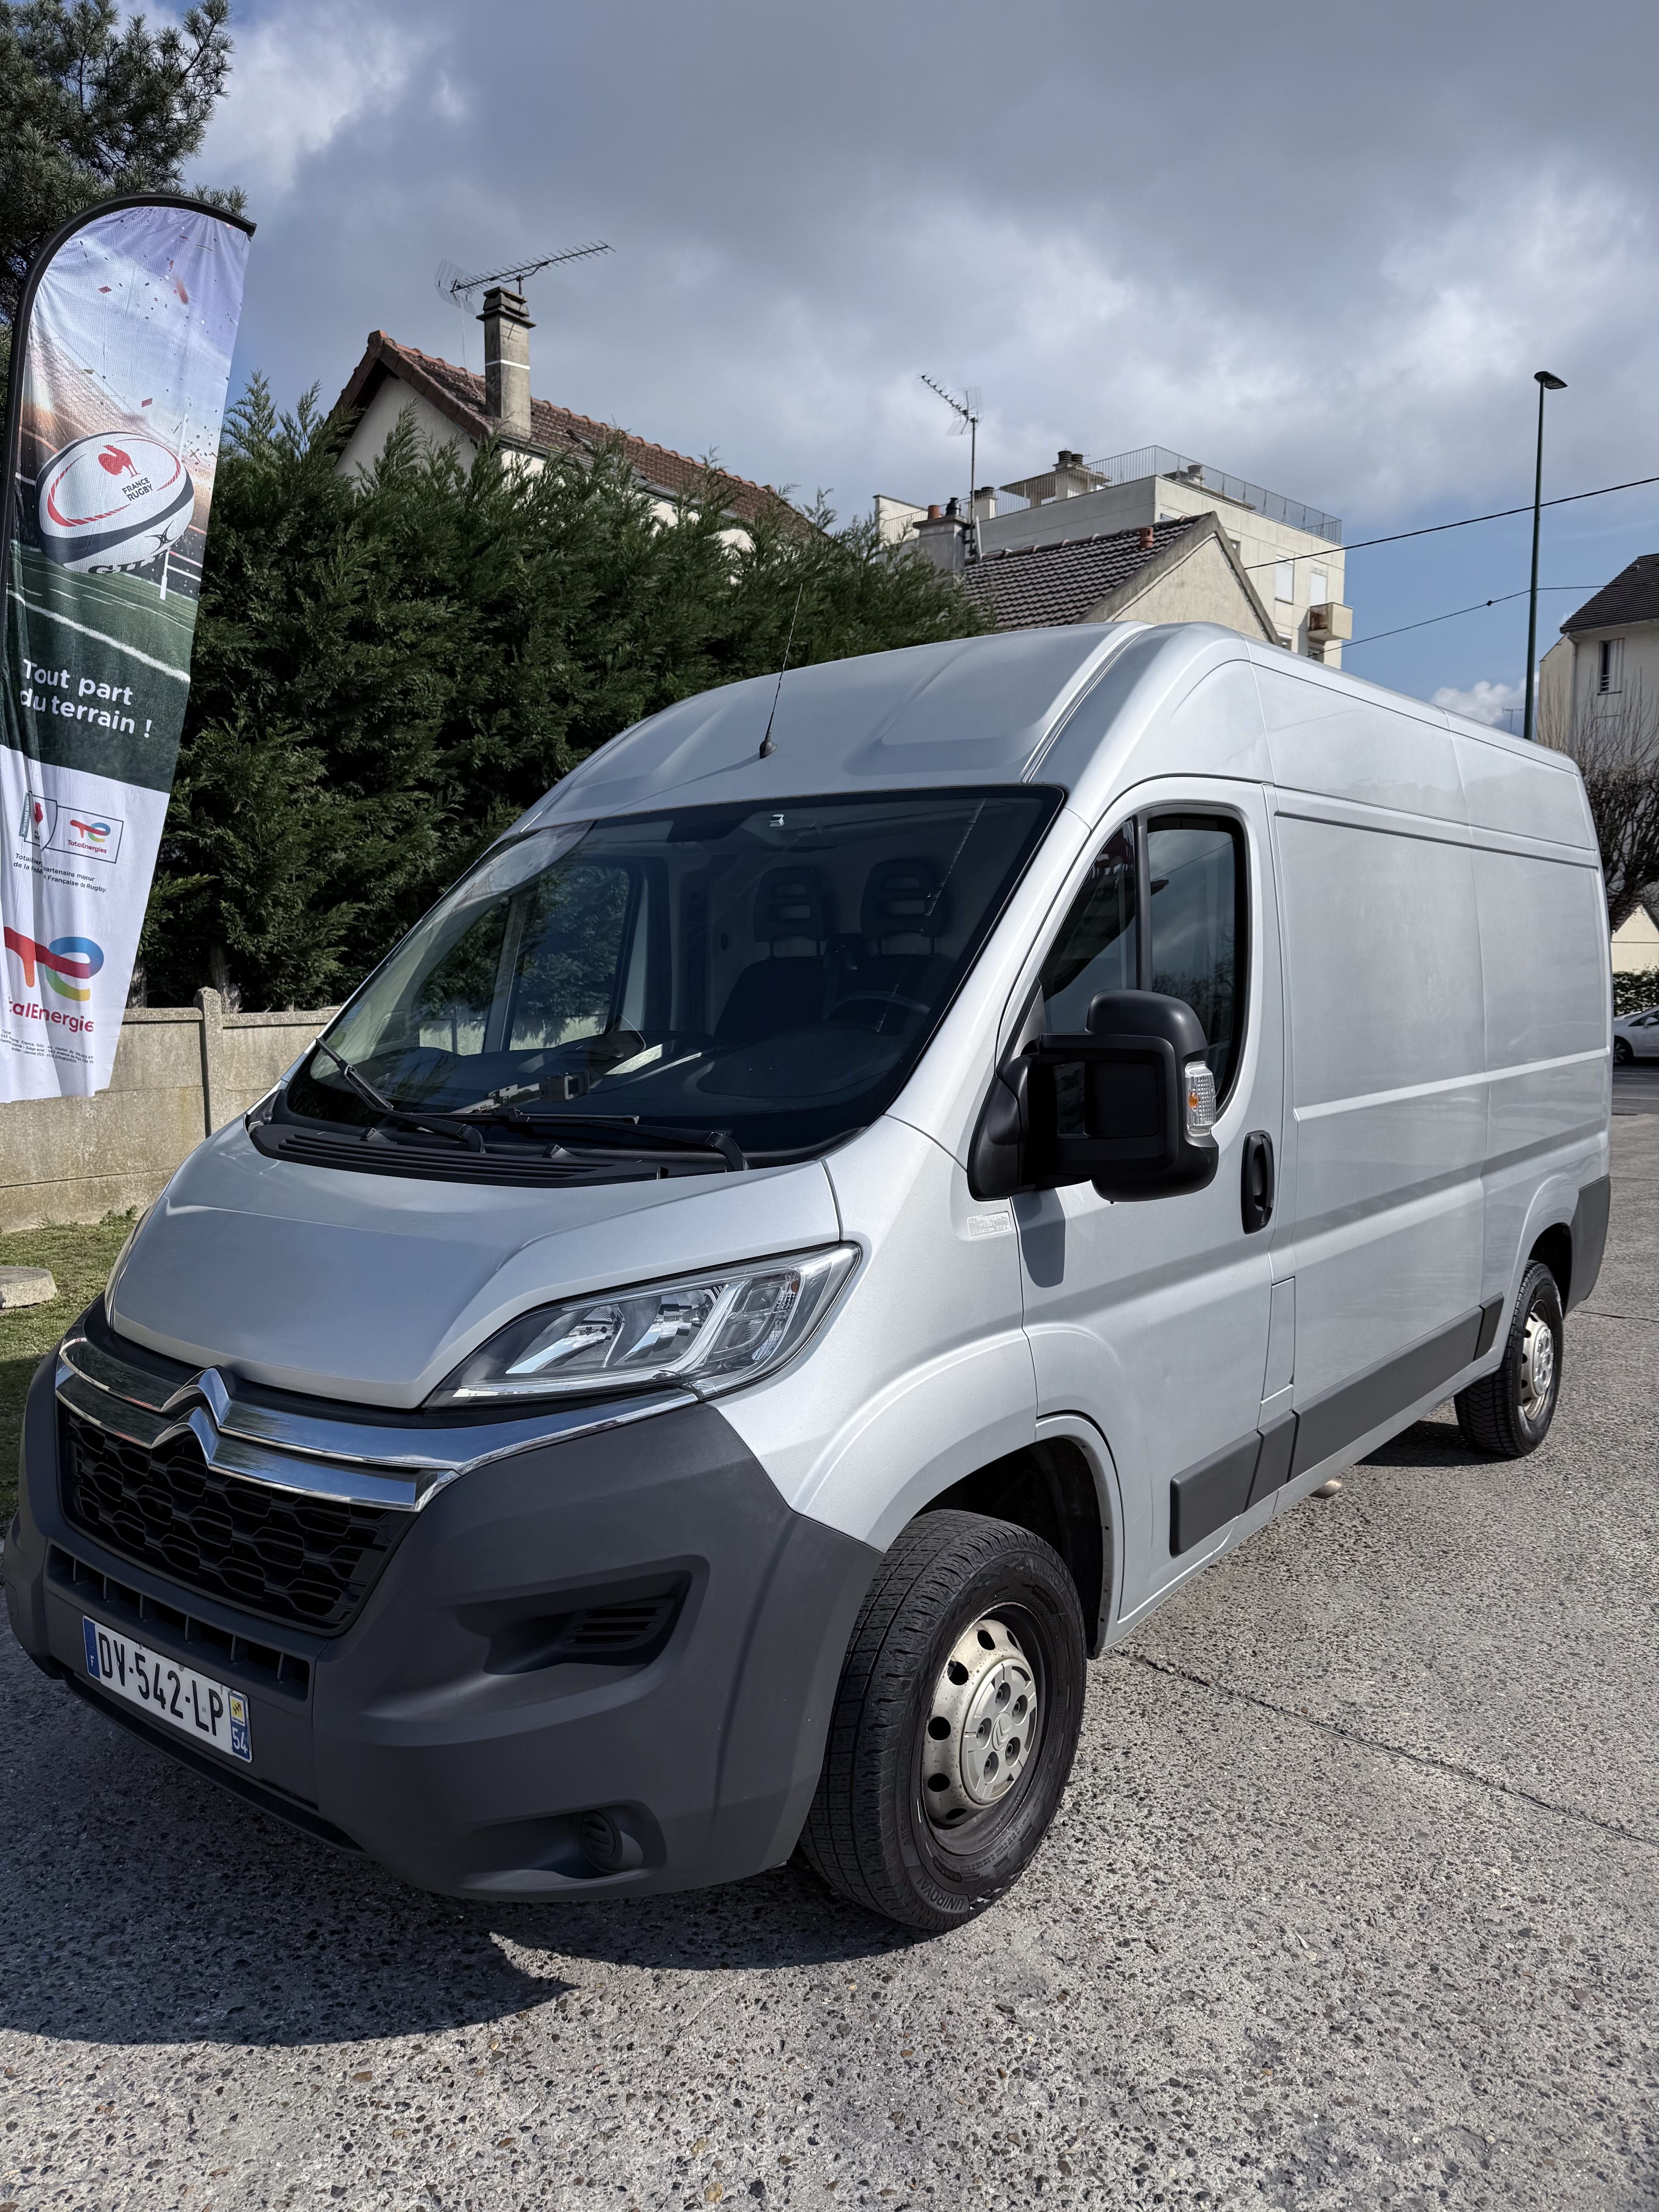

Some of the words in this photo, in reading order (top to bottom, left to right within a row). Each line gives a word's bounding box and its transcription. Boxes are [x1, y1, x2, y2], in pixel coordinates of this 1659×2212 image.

[122, 477, 150, 494] FRANCE
[126, 484, 153, 501] RUGBY
[23, 659, 70, 689] Tout
[78, 678, 133, 706] part
[20, 688, 46, 712] du
[52, 696, 135, 734] terrain
[48, 875, 79, 886] Française
[90, 1655, 94, 1666] F
[98, 1632, 223, 1736] DV-542-LP
[232, 1727, 248, 1754] 54
